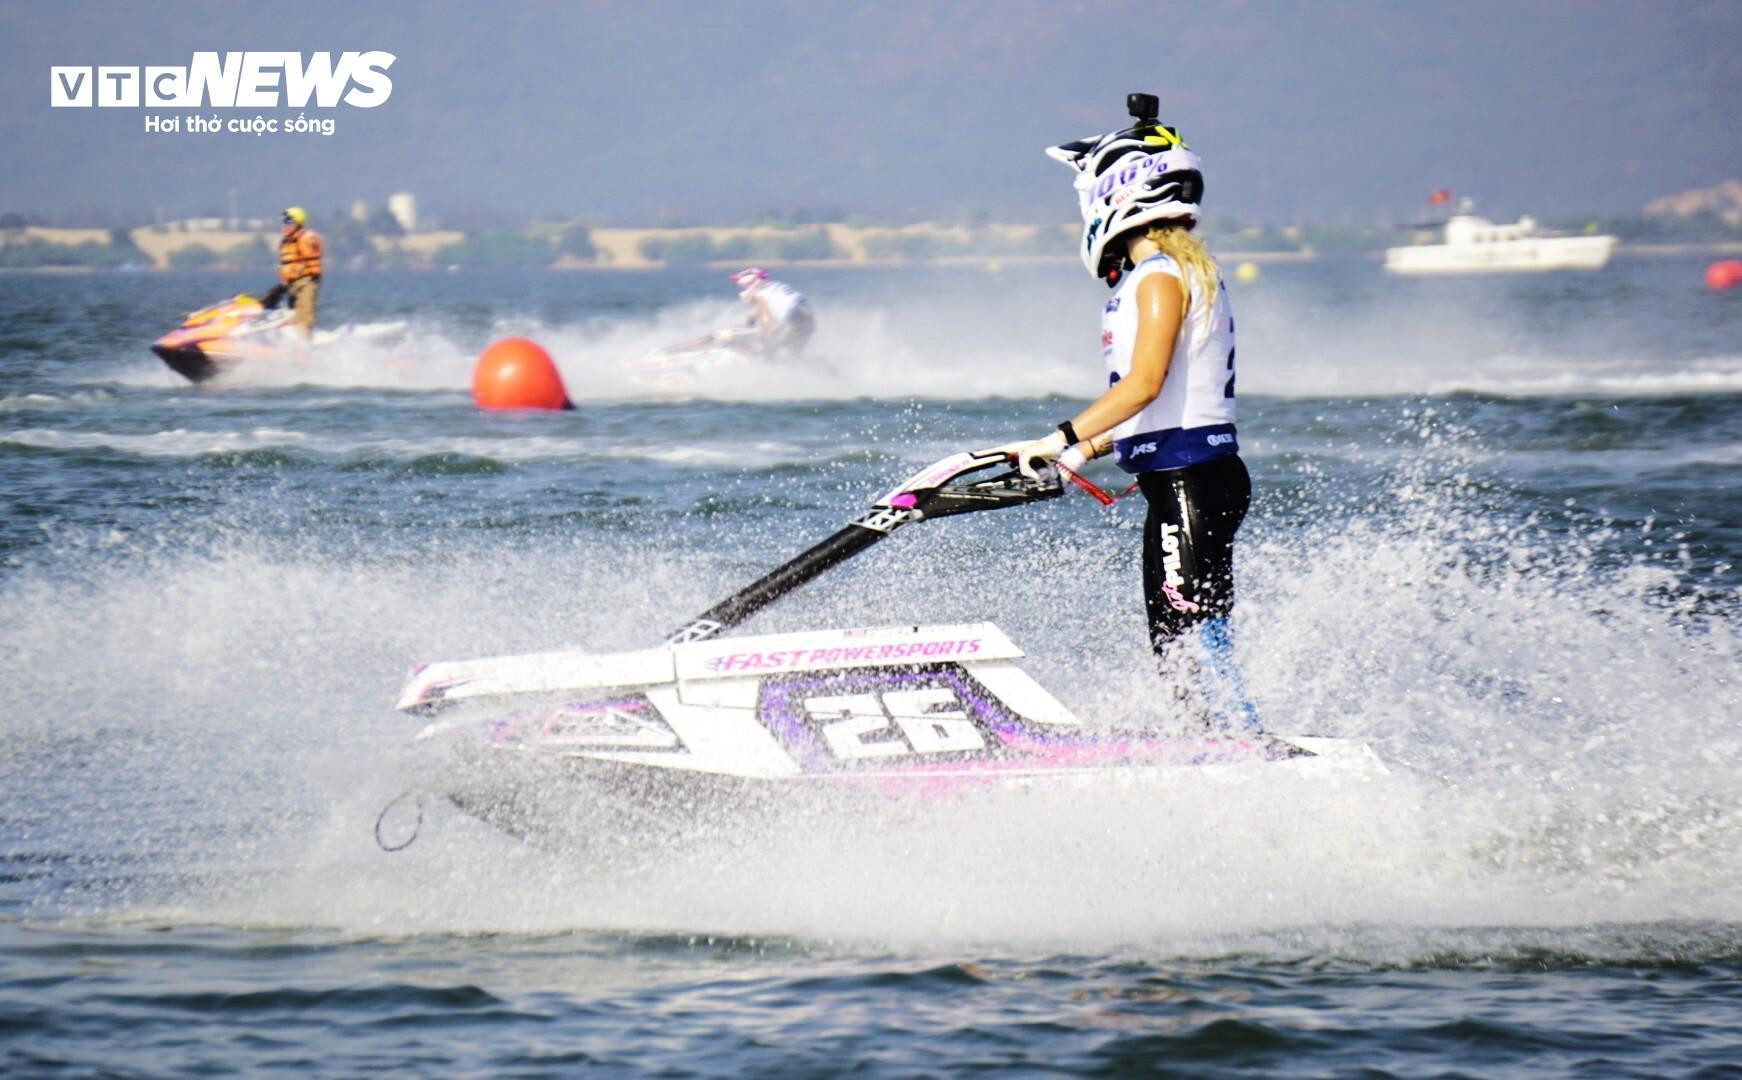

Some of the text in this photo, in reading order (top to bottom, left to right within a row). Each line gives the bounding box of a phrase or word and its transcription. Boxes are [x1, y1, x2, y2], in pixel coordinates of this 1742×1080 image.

[1088, 154, 1168, 205] 100%
[721, 638, 983, 671] FAST POWERSPORTS
[804, 688, 986, 759] 26
